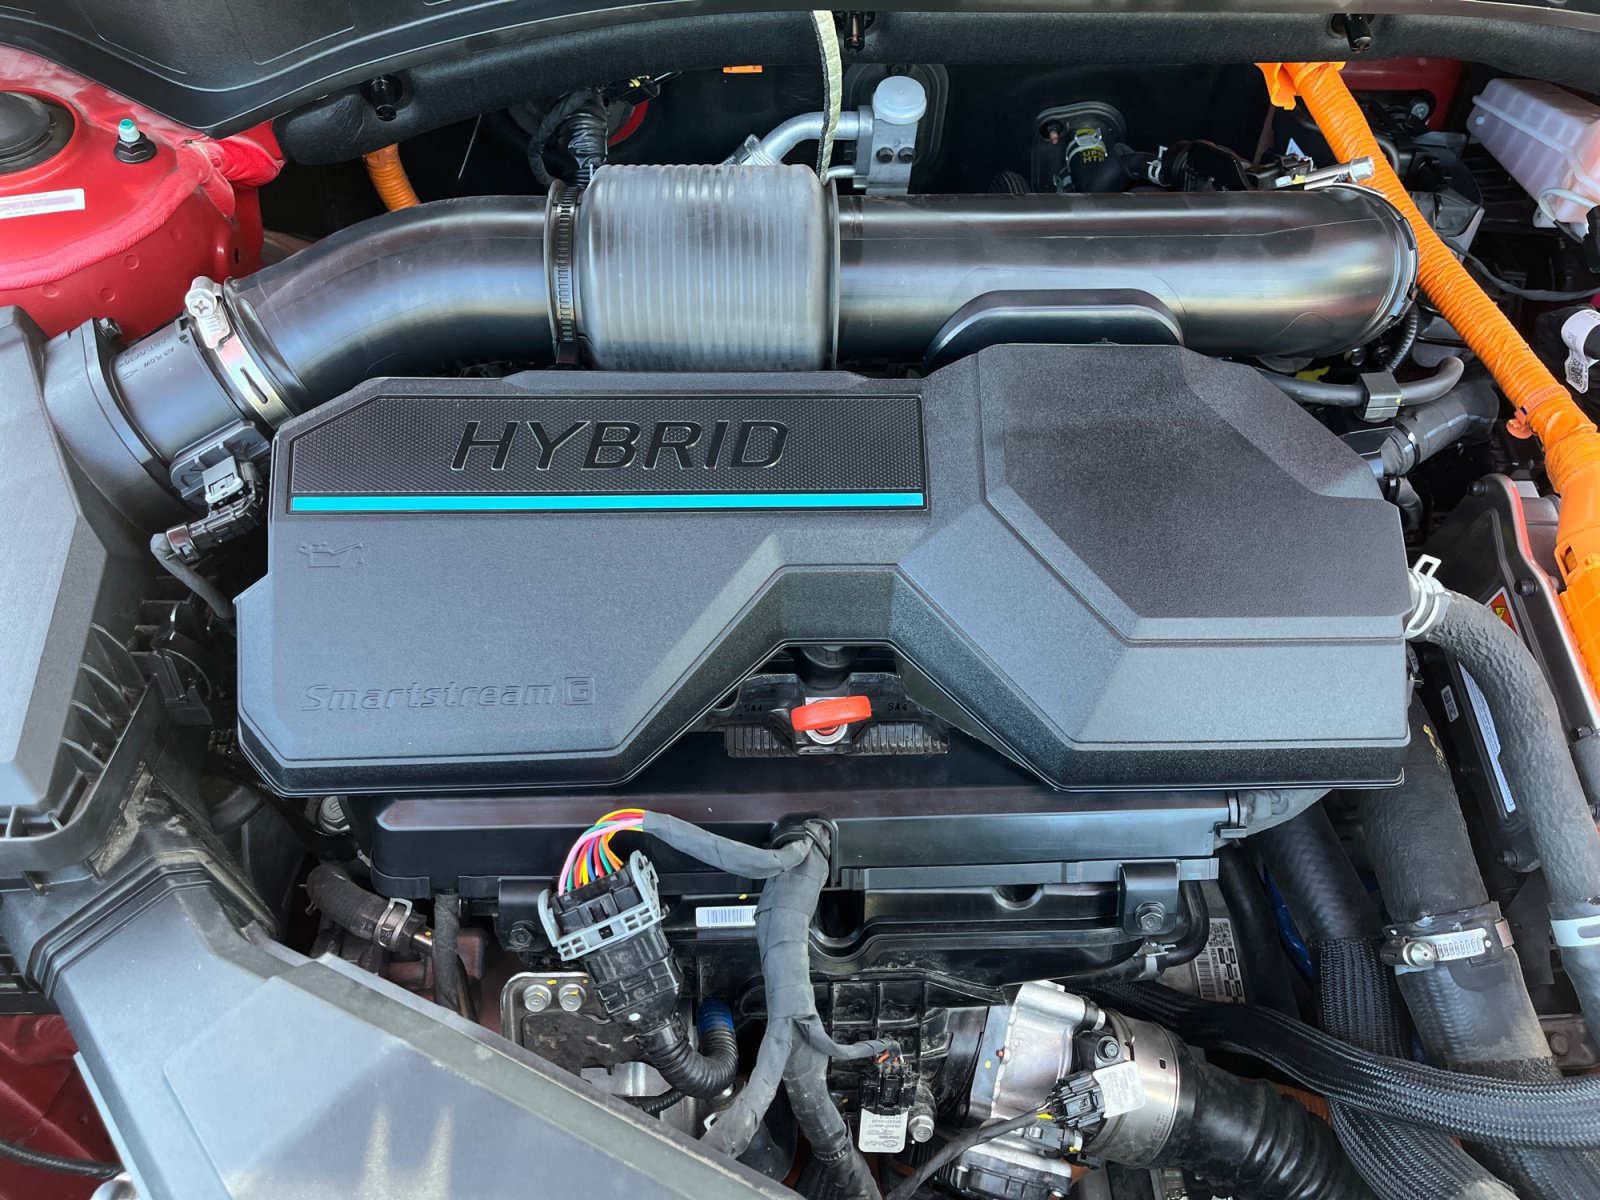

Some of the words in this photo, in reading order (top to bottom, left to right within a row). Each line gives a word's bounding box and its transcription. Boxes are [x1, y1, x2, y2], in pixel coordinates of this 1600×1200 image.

[144, 354, 162, 368] FLOW
[450, 420, 788, 470] HYBRID
[301, 681, 553, 711] Smartstream
[567, 679, 591, 703] G
